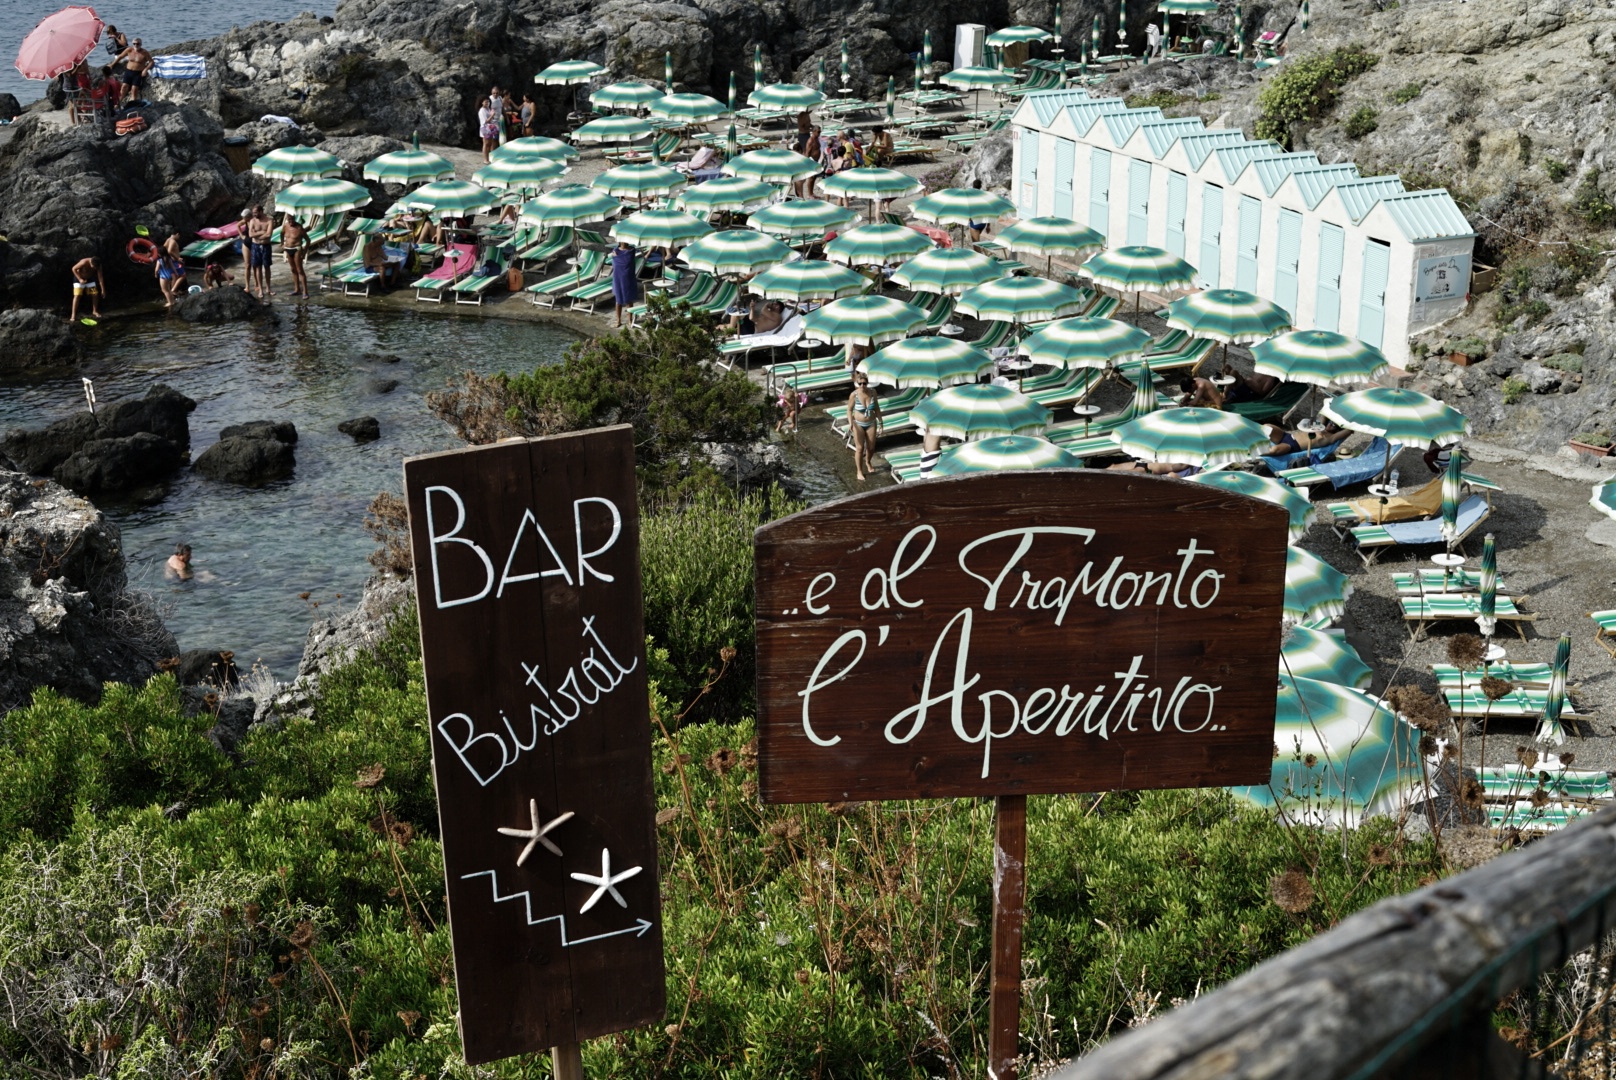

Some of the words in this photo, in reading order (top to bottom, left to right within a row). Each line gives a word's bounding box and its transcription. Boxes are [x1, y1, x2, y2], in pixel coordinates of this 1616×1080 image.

[424, 485, 622, 609] BAR
[860, 524, 937, 611] al
[437, 615, 638, 787] Bistrot
